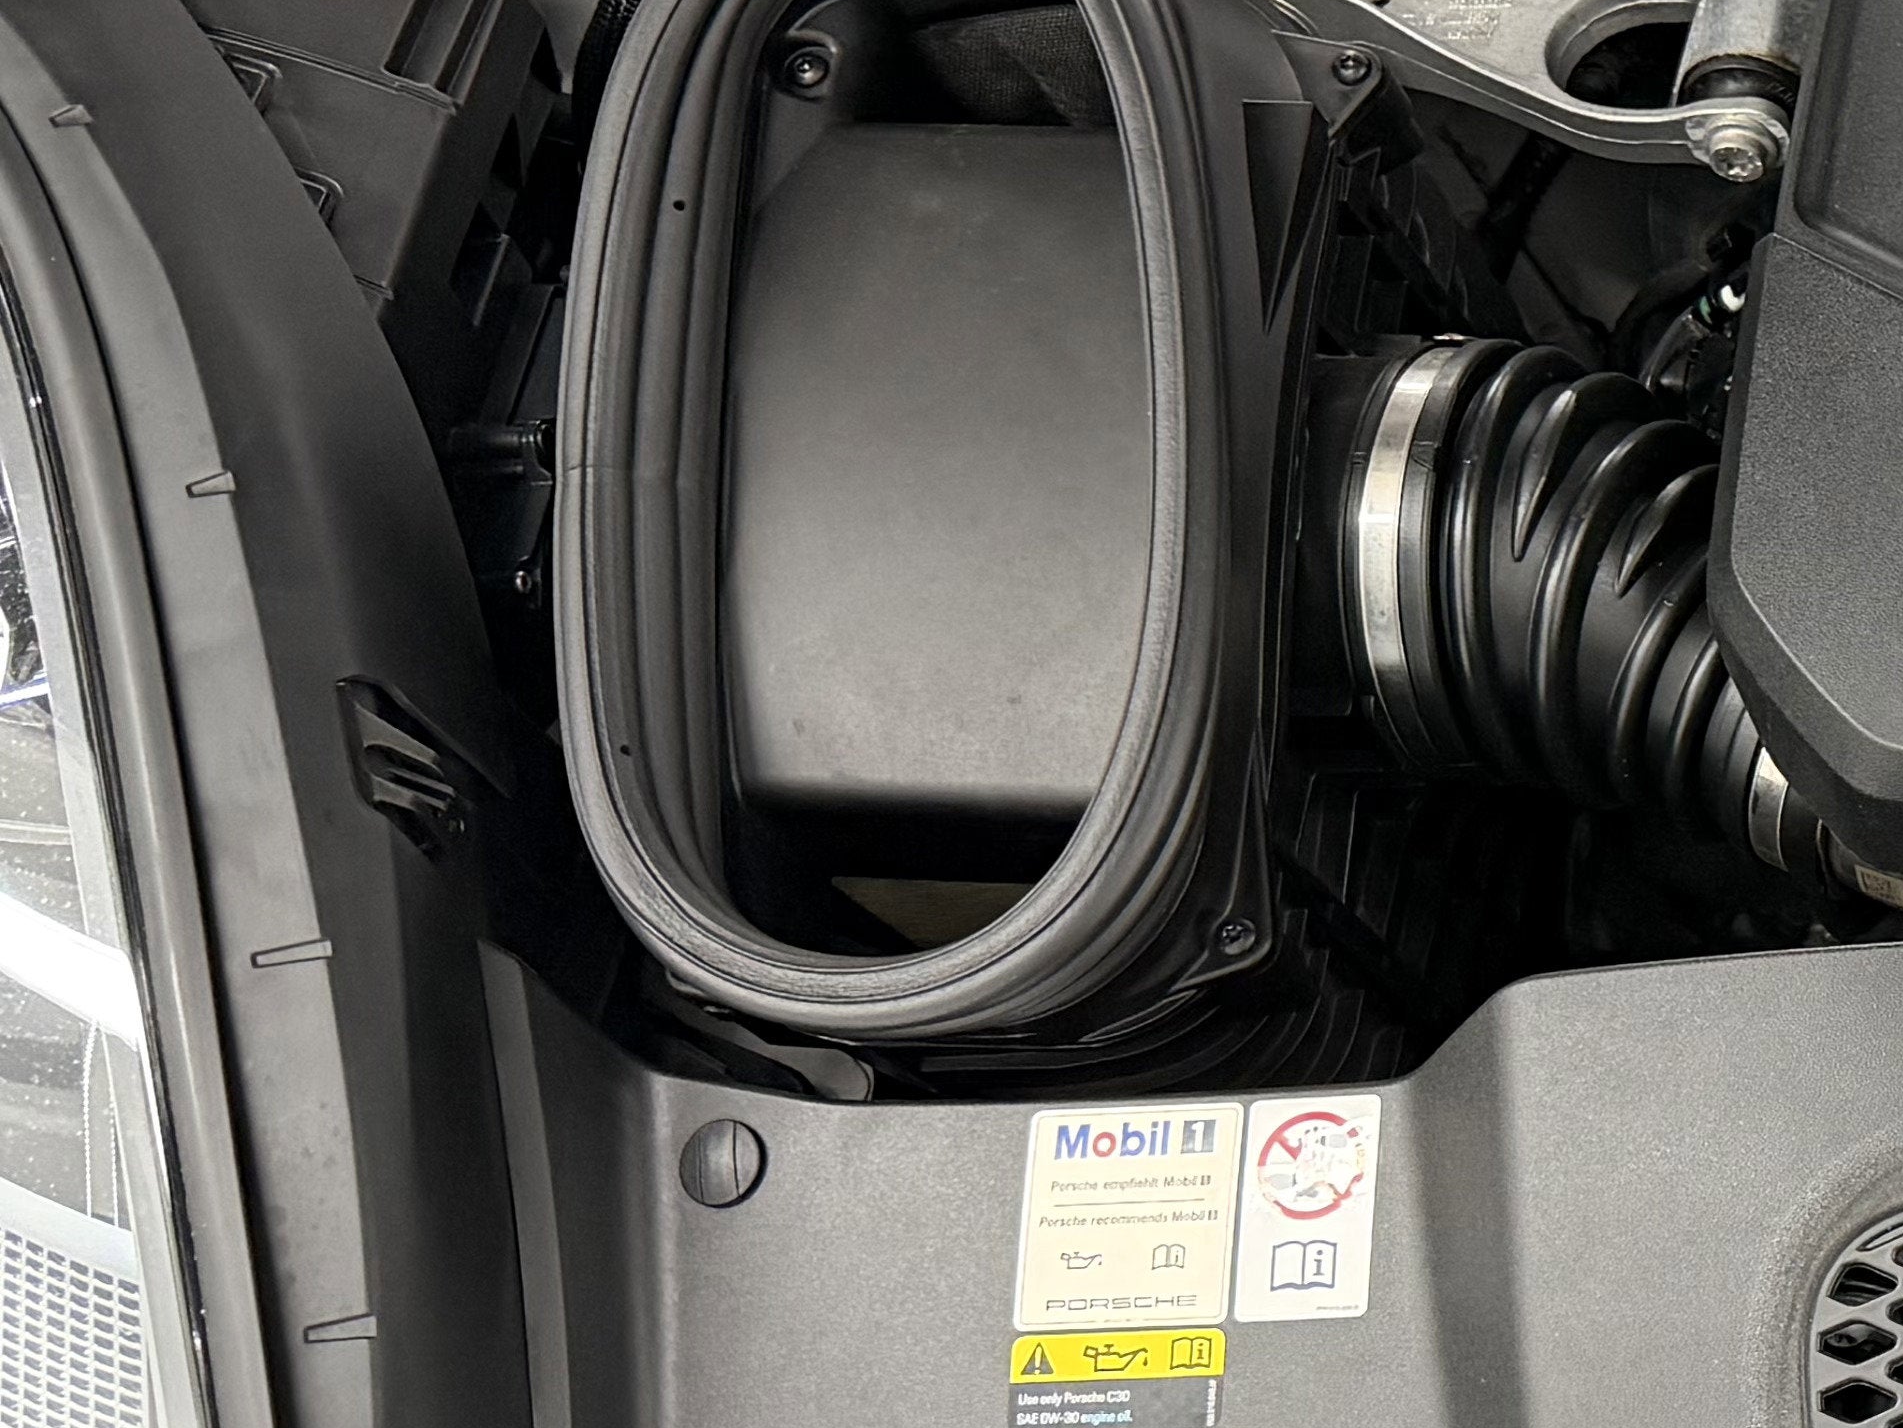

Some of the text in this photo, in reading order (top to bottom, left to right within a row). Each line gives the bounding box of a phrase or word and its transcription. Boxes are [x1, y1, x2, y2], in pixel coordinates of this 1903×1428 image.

[1054, 1120, 1212, 1160] Mobil 1
[1051, 1180, 1098, 1192] Porsche
[1039, 1216, 1087, 1228] Porsche
[1091, 1212, 1168, 1226] recommends
[1046, 1294, 1198, 1312] PORSCHE
[1018, 1393, 1038, 1406] Use
[1040, 1391, 1063, 1407] only
[1064, 1391, 1105, 1404] Porsche
[1016, 1412, 1039, 1425] SAE
[1080, 1411, 1116, 1426] engine
